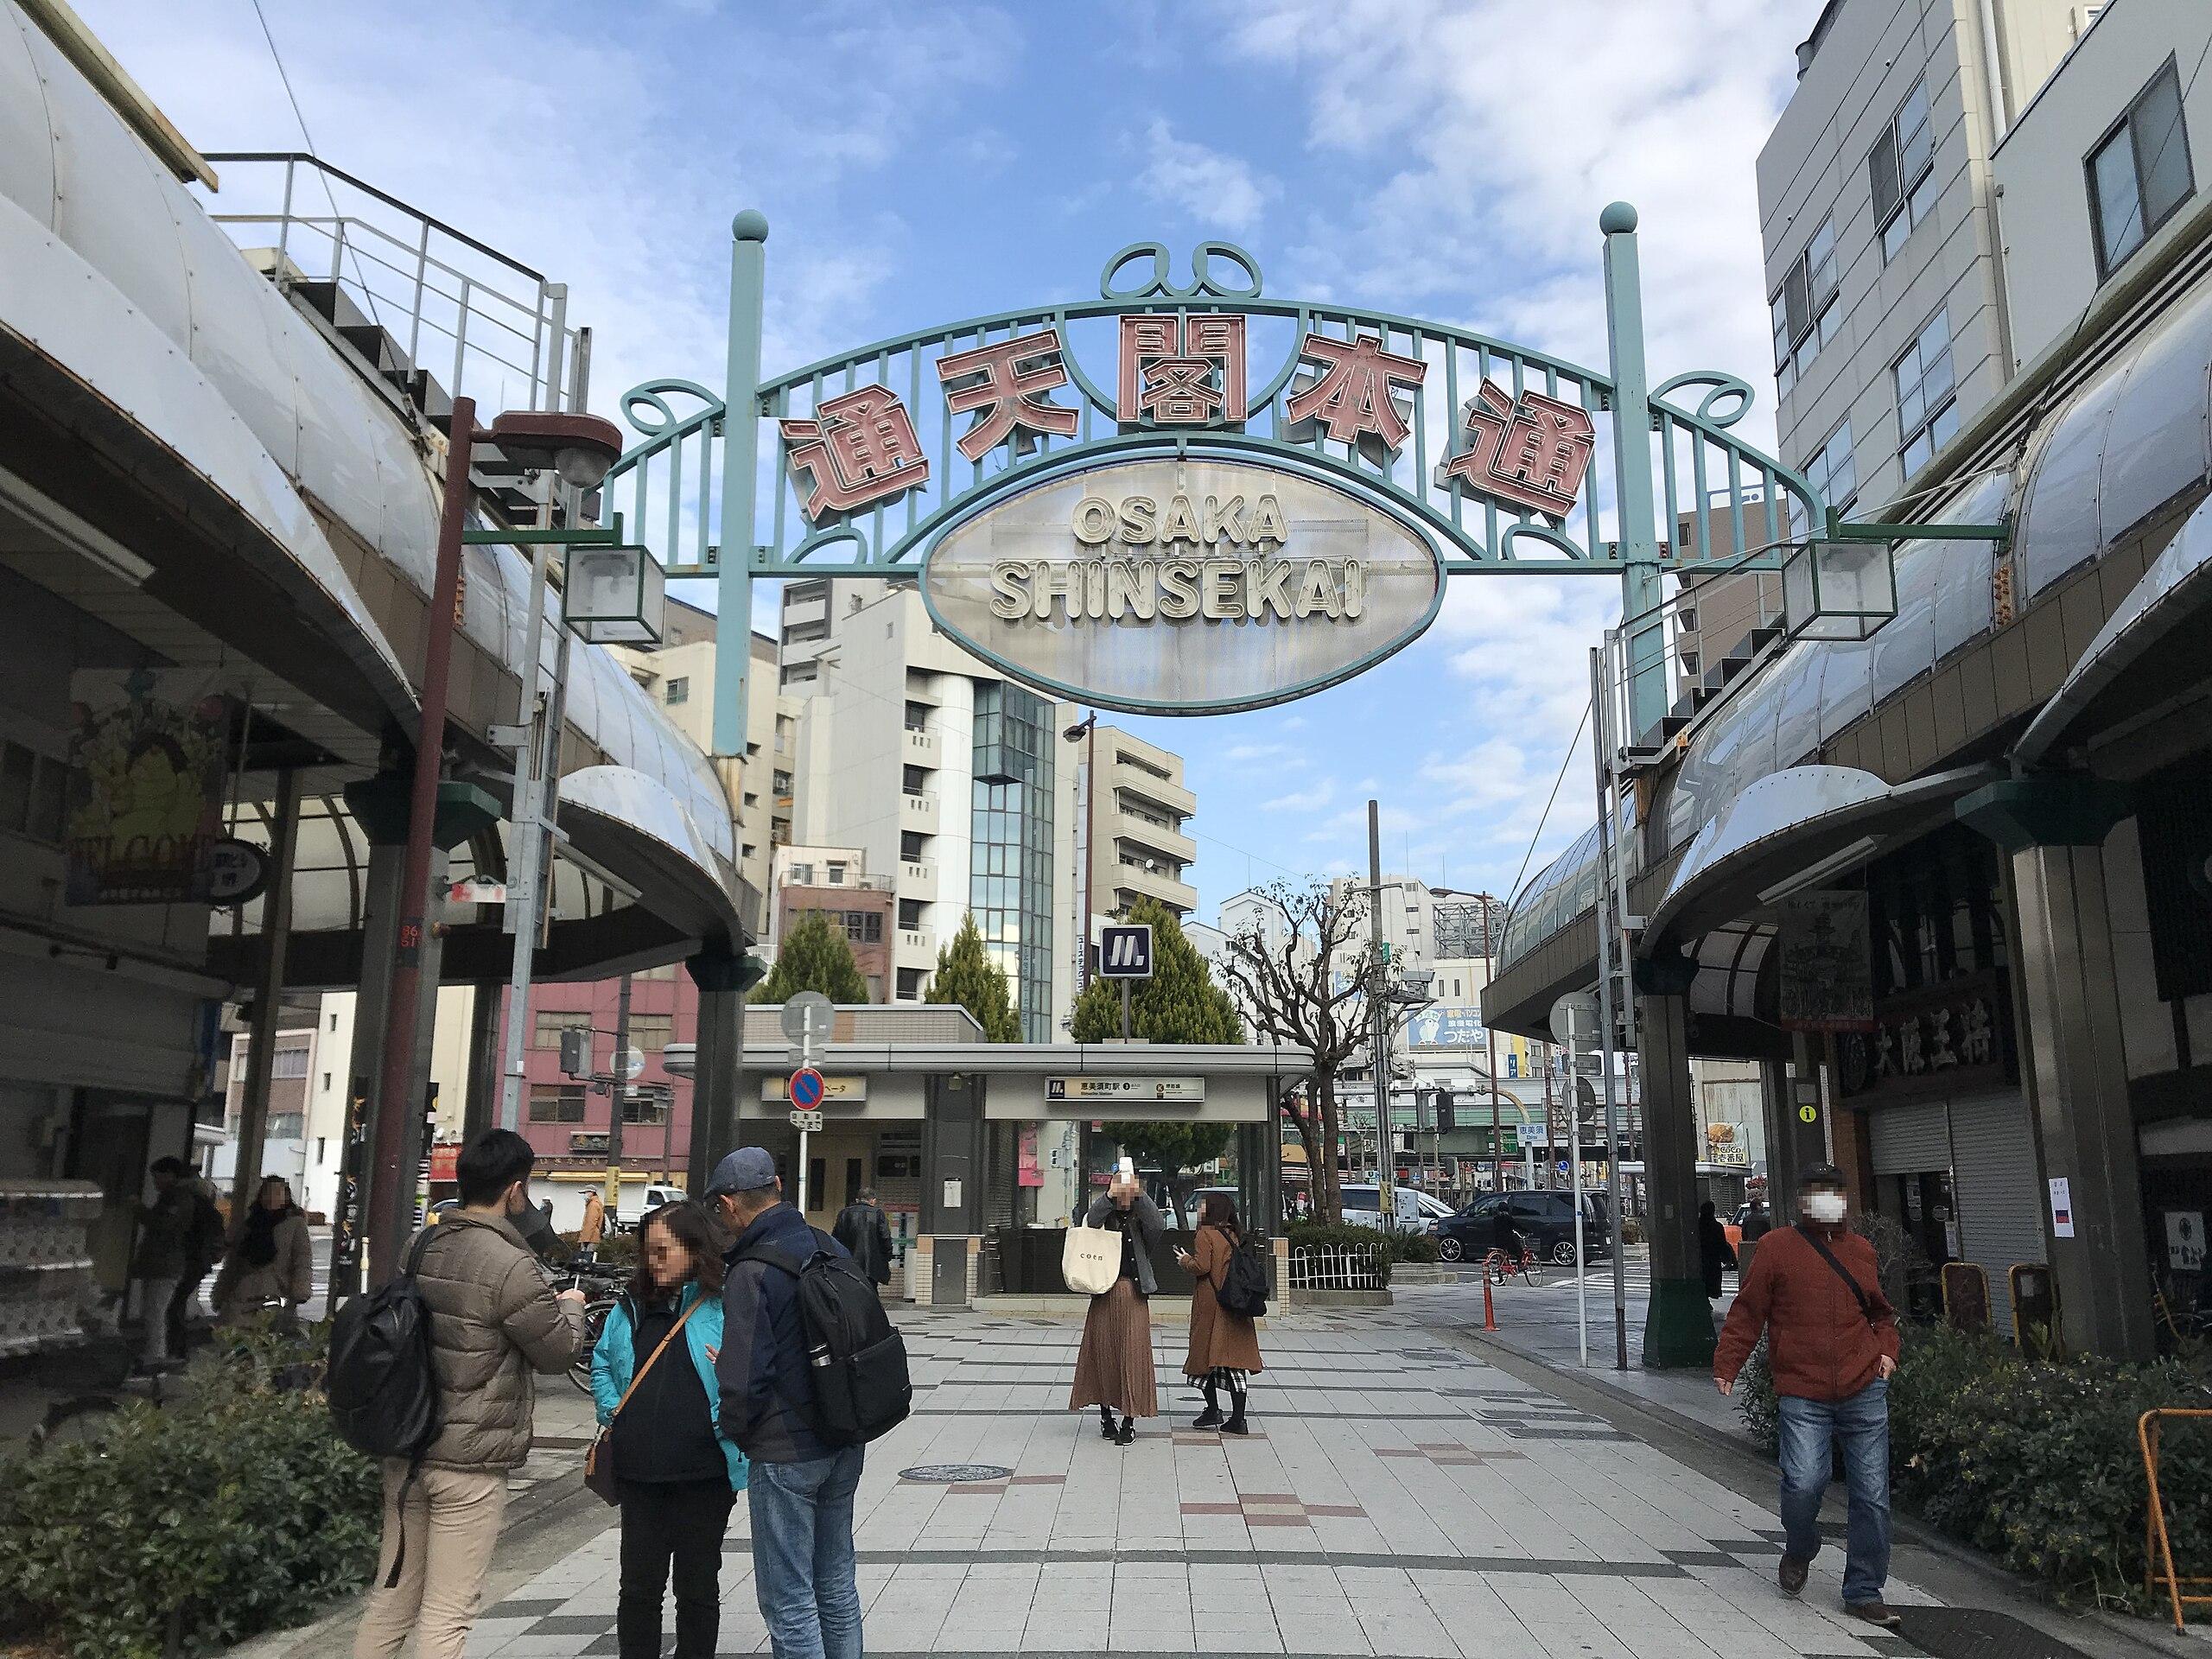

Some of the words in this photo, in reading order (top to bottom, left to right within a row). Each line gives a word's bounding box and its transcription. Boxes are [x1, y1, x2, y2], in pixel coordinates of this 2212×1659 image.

[779, 313, 1596, 522] 通天閣本通
[1071, 493, 1288, 545] OSAKA
[989, 558, 1363, 620] SHINSEKAI
[1443, 1028, 1484, 1043] つだや
[1519, 1125, 1544, 1135] 恵美須
